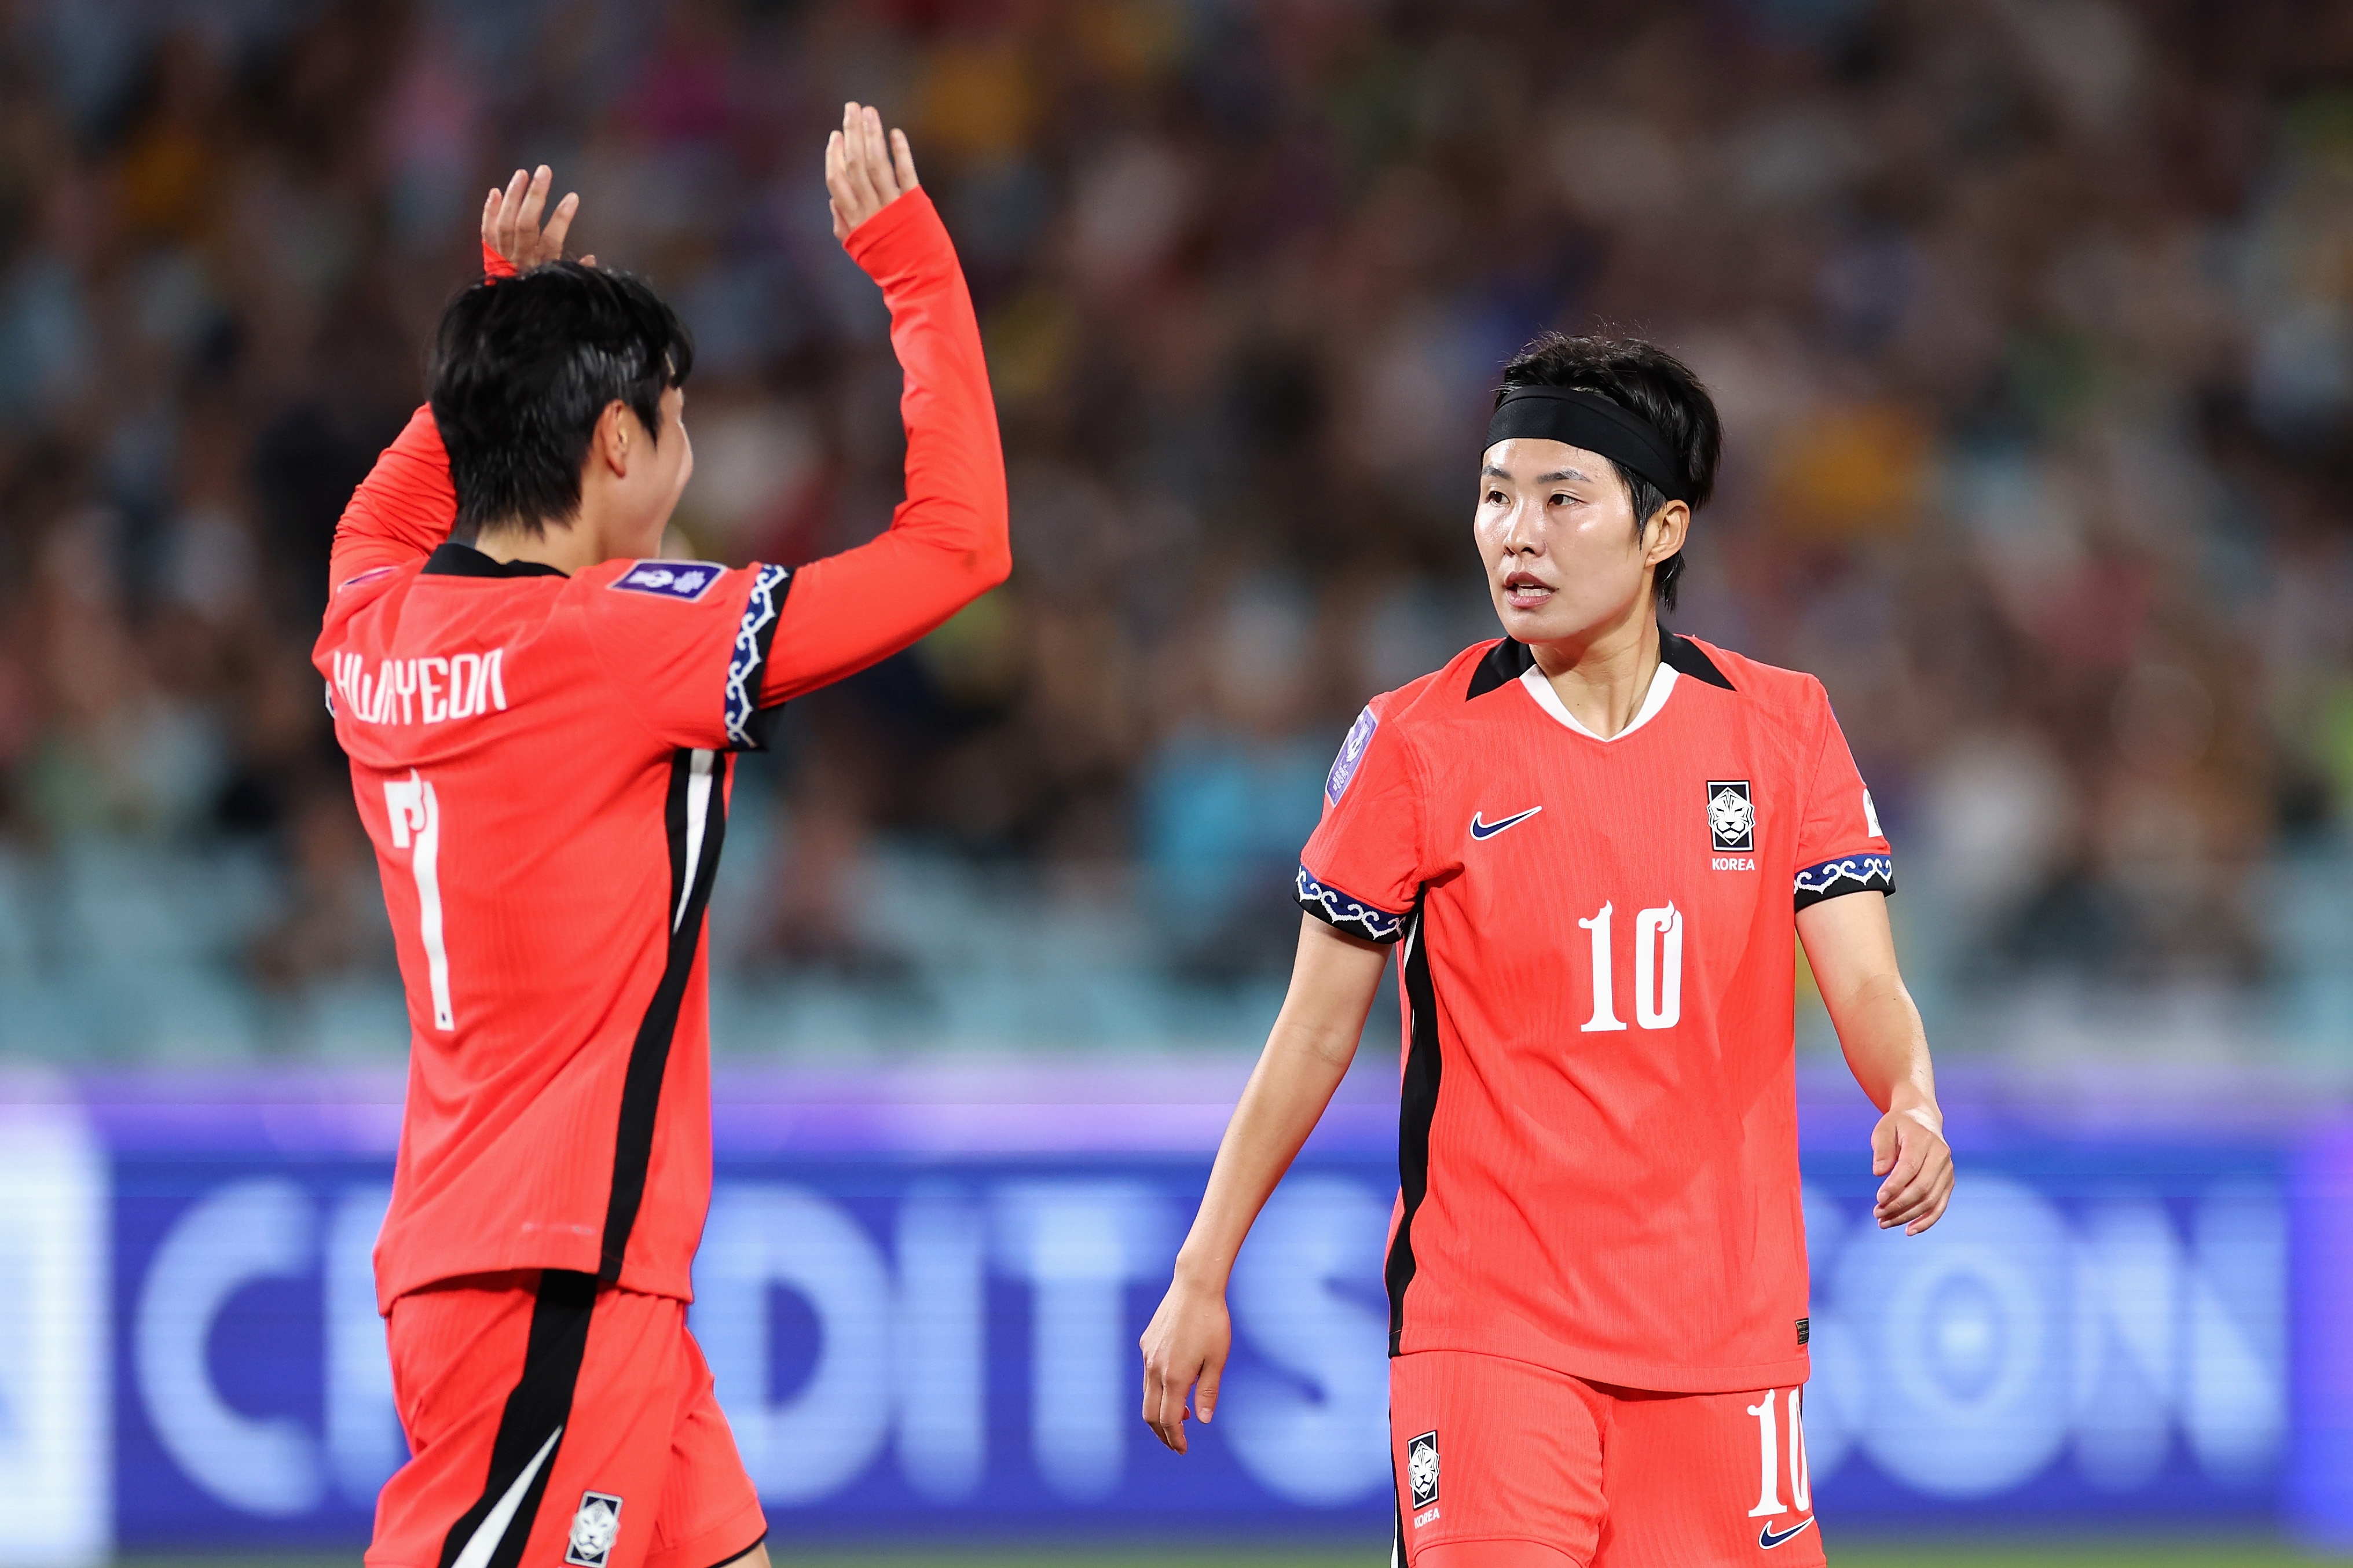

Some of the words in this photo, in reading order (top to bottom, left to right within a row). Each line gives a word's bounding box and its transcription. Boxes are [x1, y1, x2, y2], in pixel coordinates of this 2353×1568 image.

[333, 648, 507, 725] HWAYEON
[384, 768, 454, 1030] 7
[1712, 858, 1755, 871] KOREA
[1578, 899, 1683, 1032] 10
[1747, 1386, 1809, 1518] 10
[1414, 1508, 1441, 1529] KOREA
